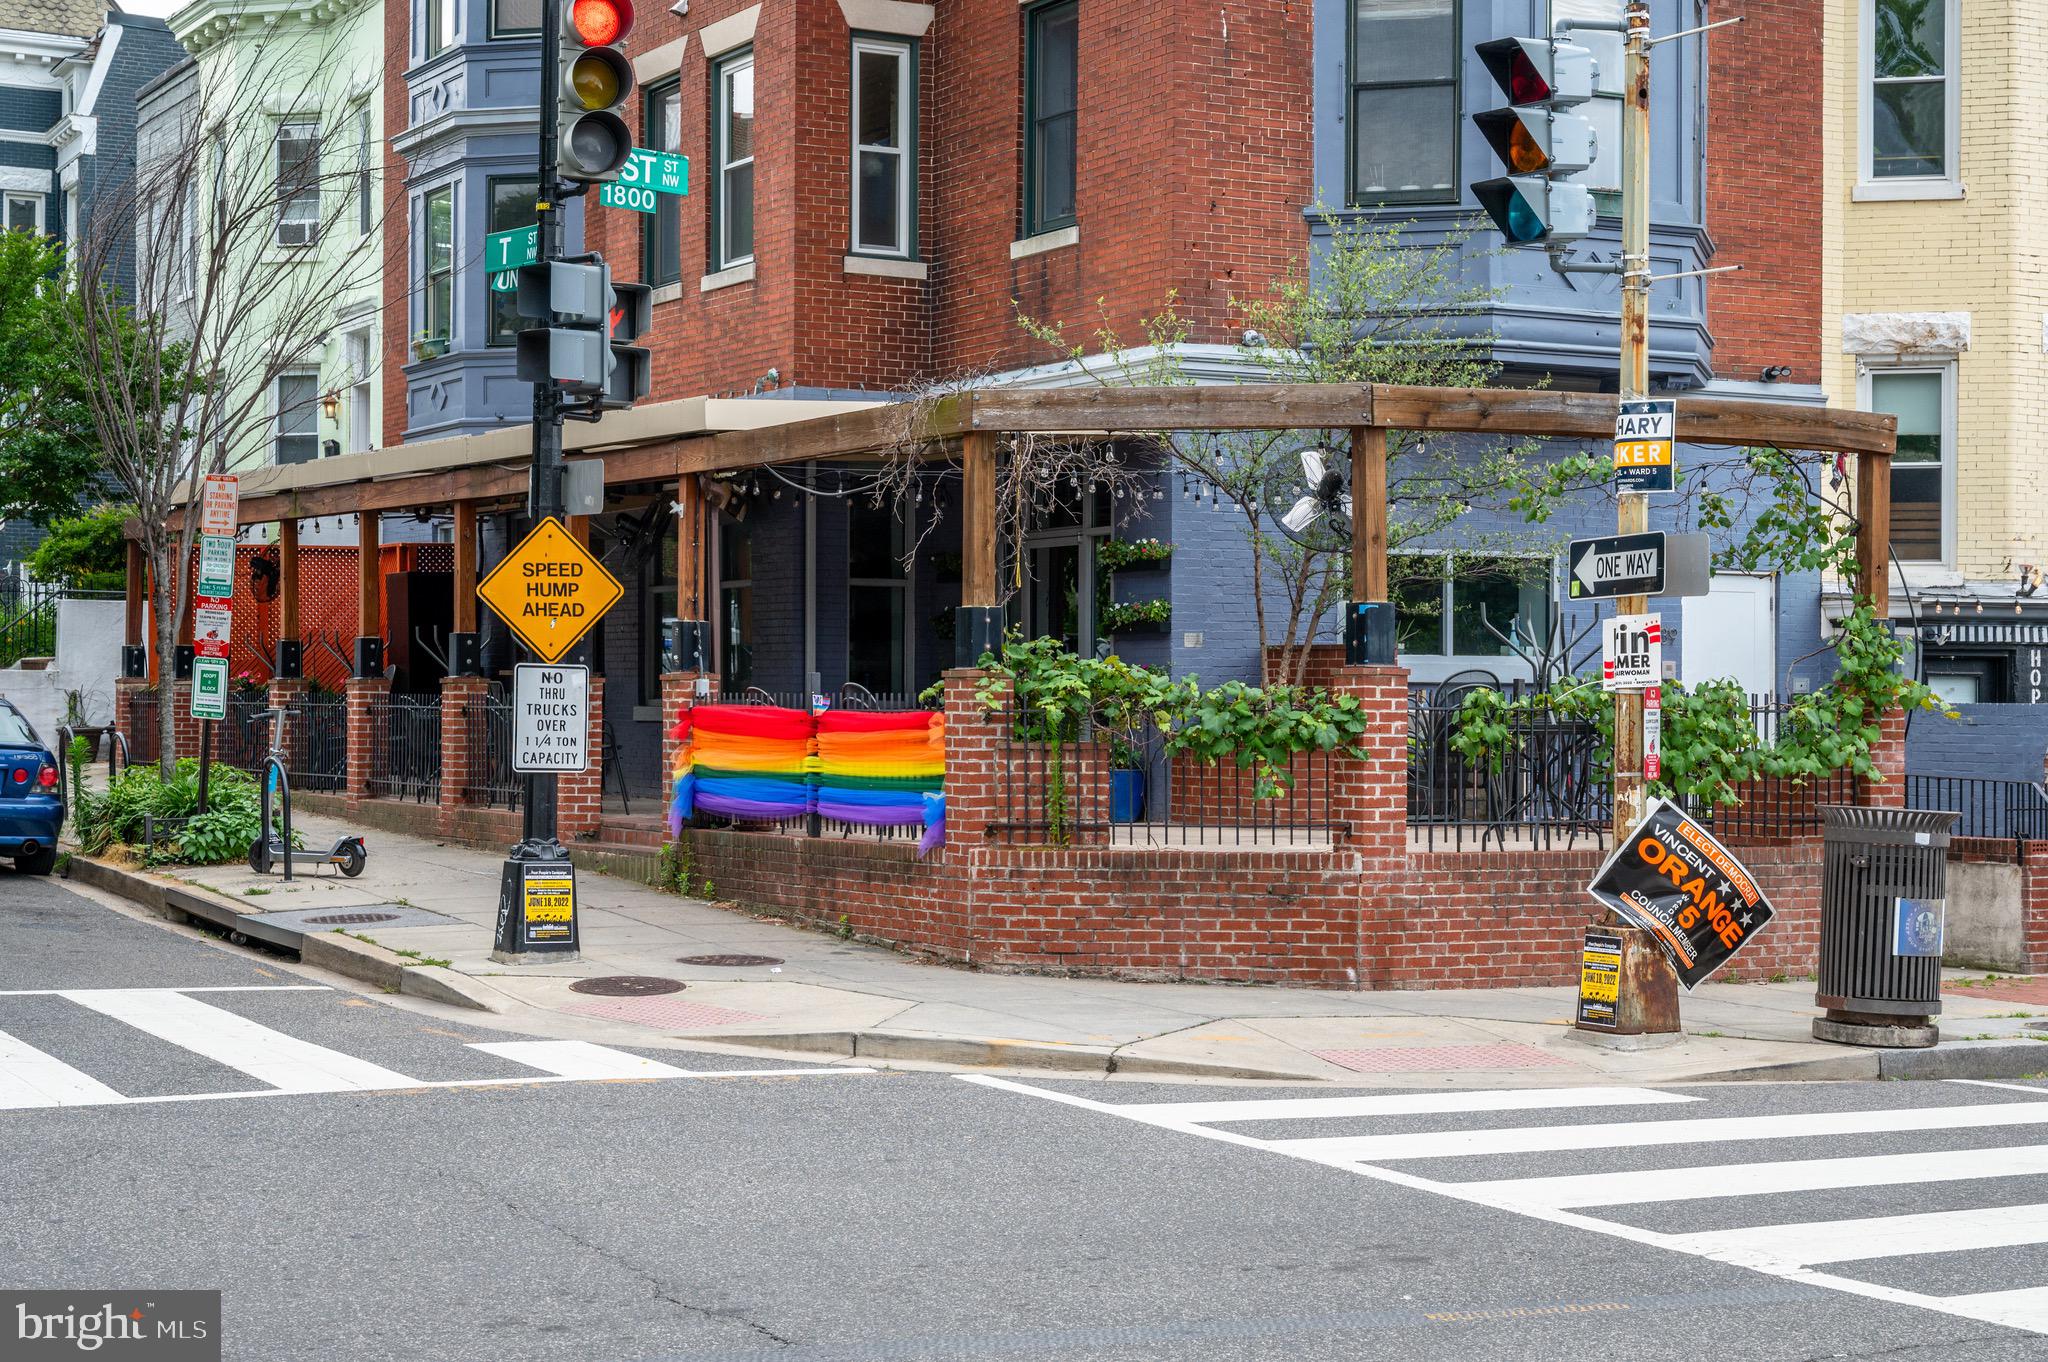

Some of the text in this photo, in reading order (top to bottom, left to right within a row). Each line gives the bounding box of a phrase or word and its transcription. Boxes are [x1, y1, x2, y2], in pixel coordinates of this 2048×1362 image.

[617, 153, 656, 184] ST
[664, 159, 679, 173] ST
[662, 175, 680, 188] NW
[603, 184, 655, 210] 1800
[499, 236, 512, 265] T
[1616, 416, 1663, 437] HARY
[1615, 444, 1661, 464] KER
[1629, 467, 1651, 475] WARD
[1652, 467, 1657, 475] 5
[207, 549, 228, 557] PARKING
[522, 562, 584, 577] SPEED
[1597, 552, 1653, 578] ONE WAY
[526, 582, 579, 597] HUMP
[201, 602, 228, 610] PARKING
[522, 602, 585, 617] AHEAD
[1615, 654, 1650, 669] MER
[541, 671, 563, 685] NO
[539, 687, 566, 700] THRU
[526, 703, 577, 717] TRUCKS
[536, 719, 566, 732] OVER
[557, 736, 577, 747] TON
[522, 751, 578, 765] CAPACITY
[1654, 823, 1716, 878] VINCENT
[1683, 826, 1757, 902] ELECT DEMOCRAT
[1638, 837, 1744, 950] ORANGE
[528, 897, 543, 907] JUNE
[553, 896, 569, 907] 2022
[1668, 893, 1690, 915] WARD
[1677, 904, 1701, 929] 5
[1630, 889, 1698, 961] COUNCILMEMBER
